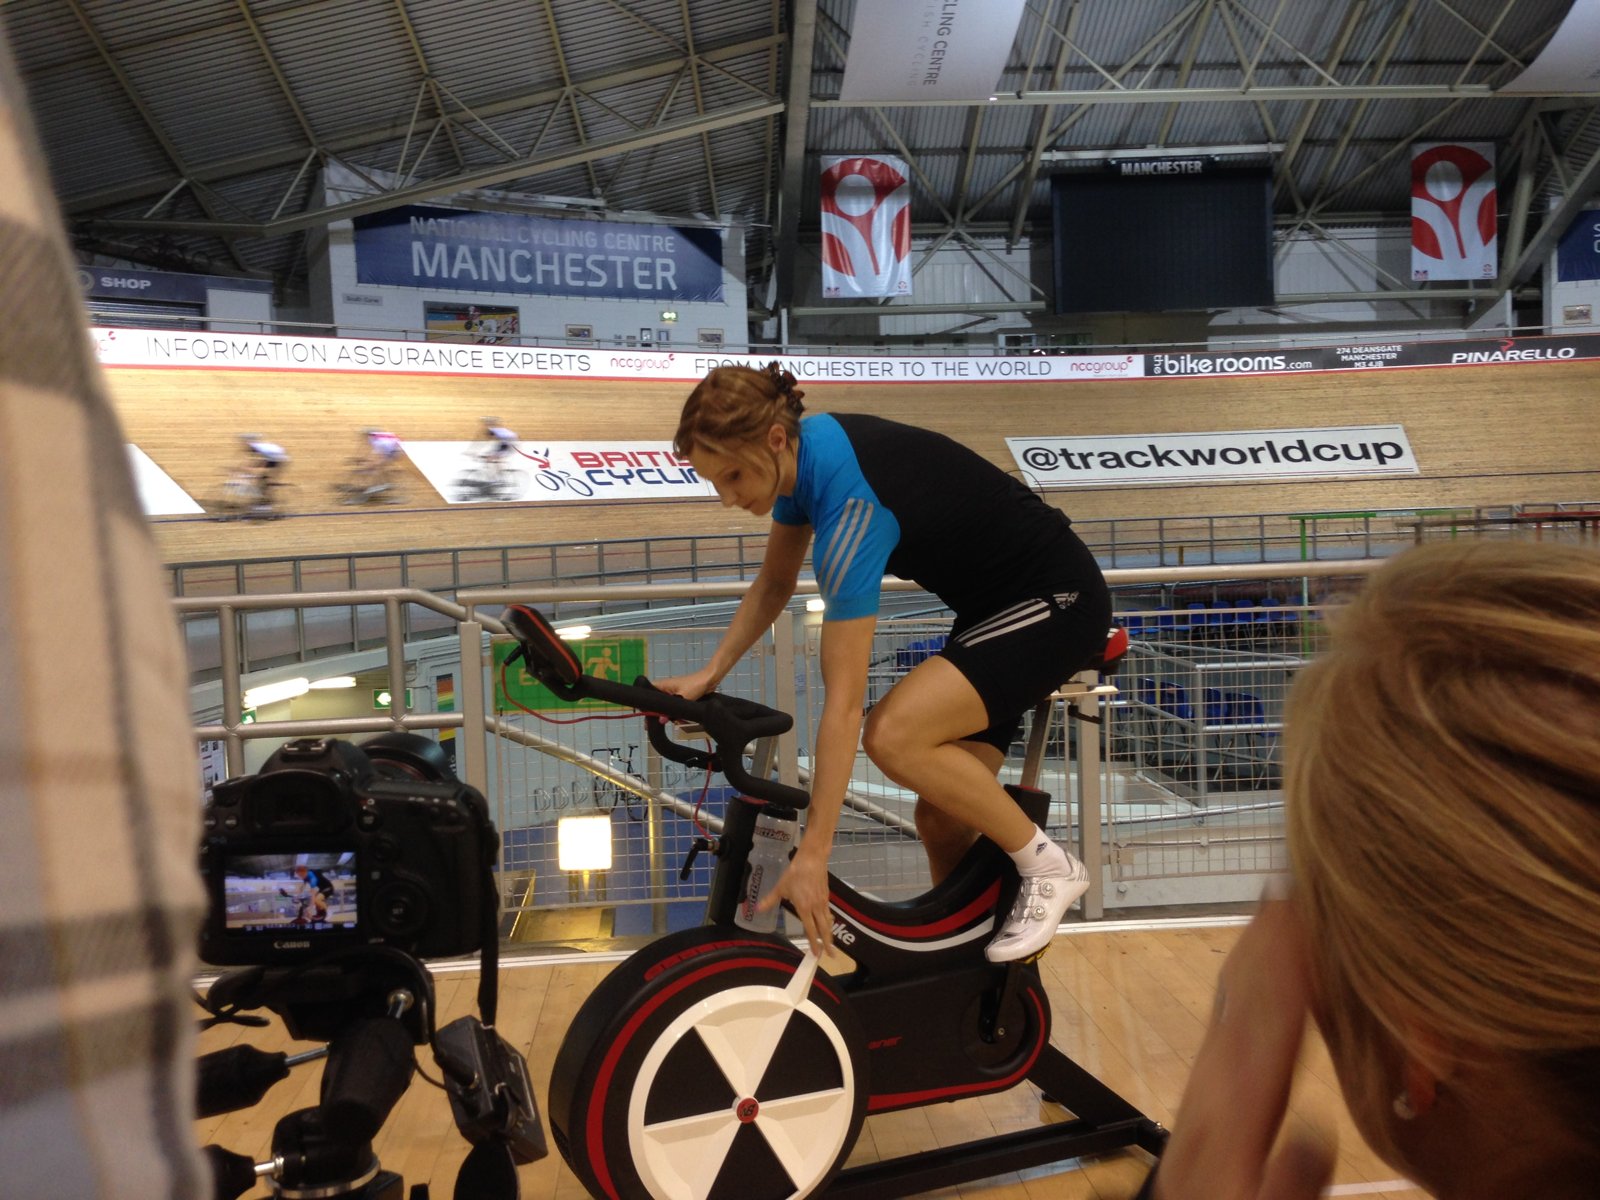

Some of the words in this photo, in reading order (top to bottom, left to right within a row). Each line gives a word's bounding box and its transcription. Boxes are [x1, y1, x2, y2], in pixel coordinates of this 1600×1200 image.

[937, 0, 958, 36] LING
[923, 40, 948, 86] CENTRE
[1121, 161, 1202, 175] MANCHESTER
[410, 216, 511, 242] NATIONAL
[518, 226, 597, 248] CYCLING
[603, 232, 675, 253] CENTRE
[411, 241, 678, 291] MANCHESTER
[101, 276, 151, 289] SHOP
[147, 335, 326, 363] INFORMATION
[337, 345, 484, 368] ASSURANCE
[492, 351, 591, 372] EXPERTS
[1336, 347, 1351, 355] 274
[1352, 345, 1403, 354] DEANSGATE
[1341, 353, 1398, 362] MANCHESTER
[1452, 347, 1576, 364] PINARELLO
[610, 355, 671, 370] nccgroup
[899, 361, 926, 377] TO
[935, 360, 969, 376] THE
[975, 360, 1052, 376] WORLD
[1070, 359, 1129, 373] nccgroup
[1022, 439, 1404, 472] @trackworldcup
[274, 940, 310, 950] Canon
